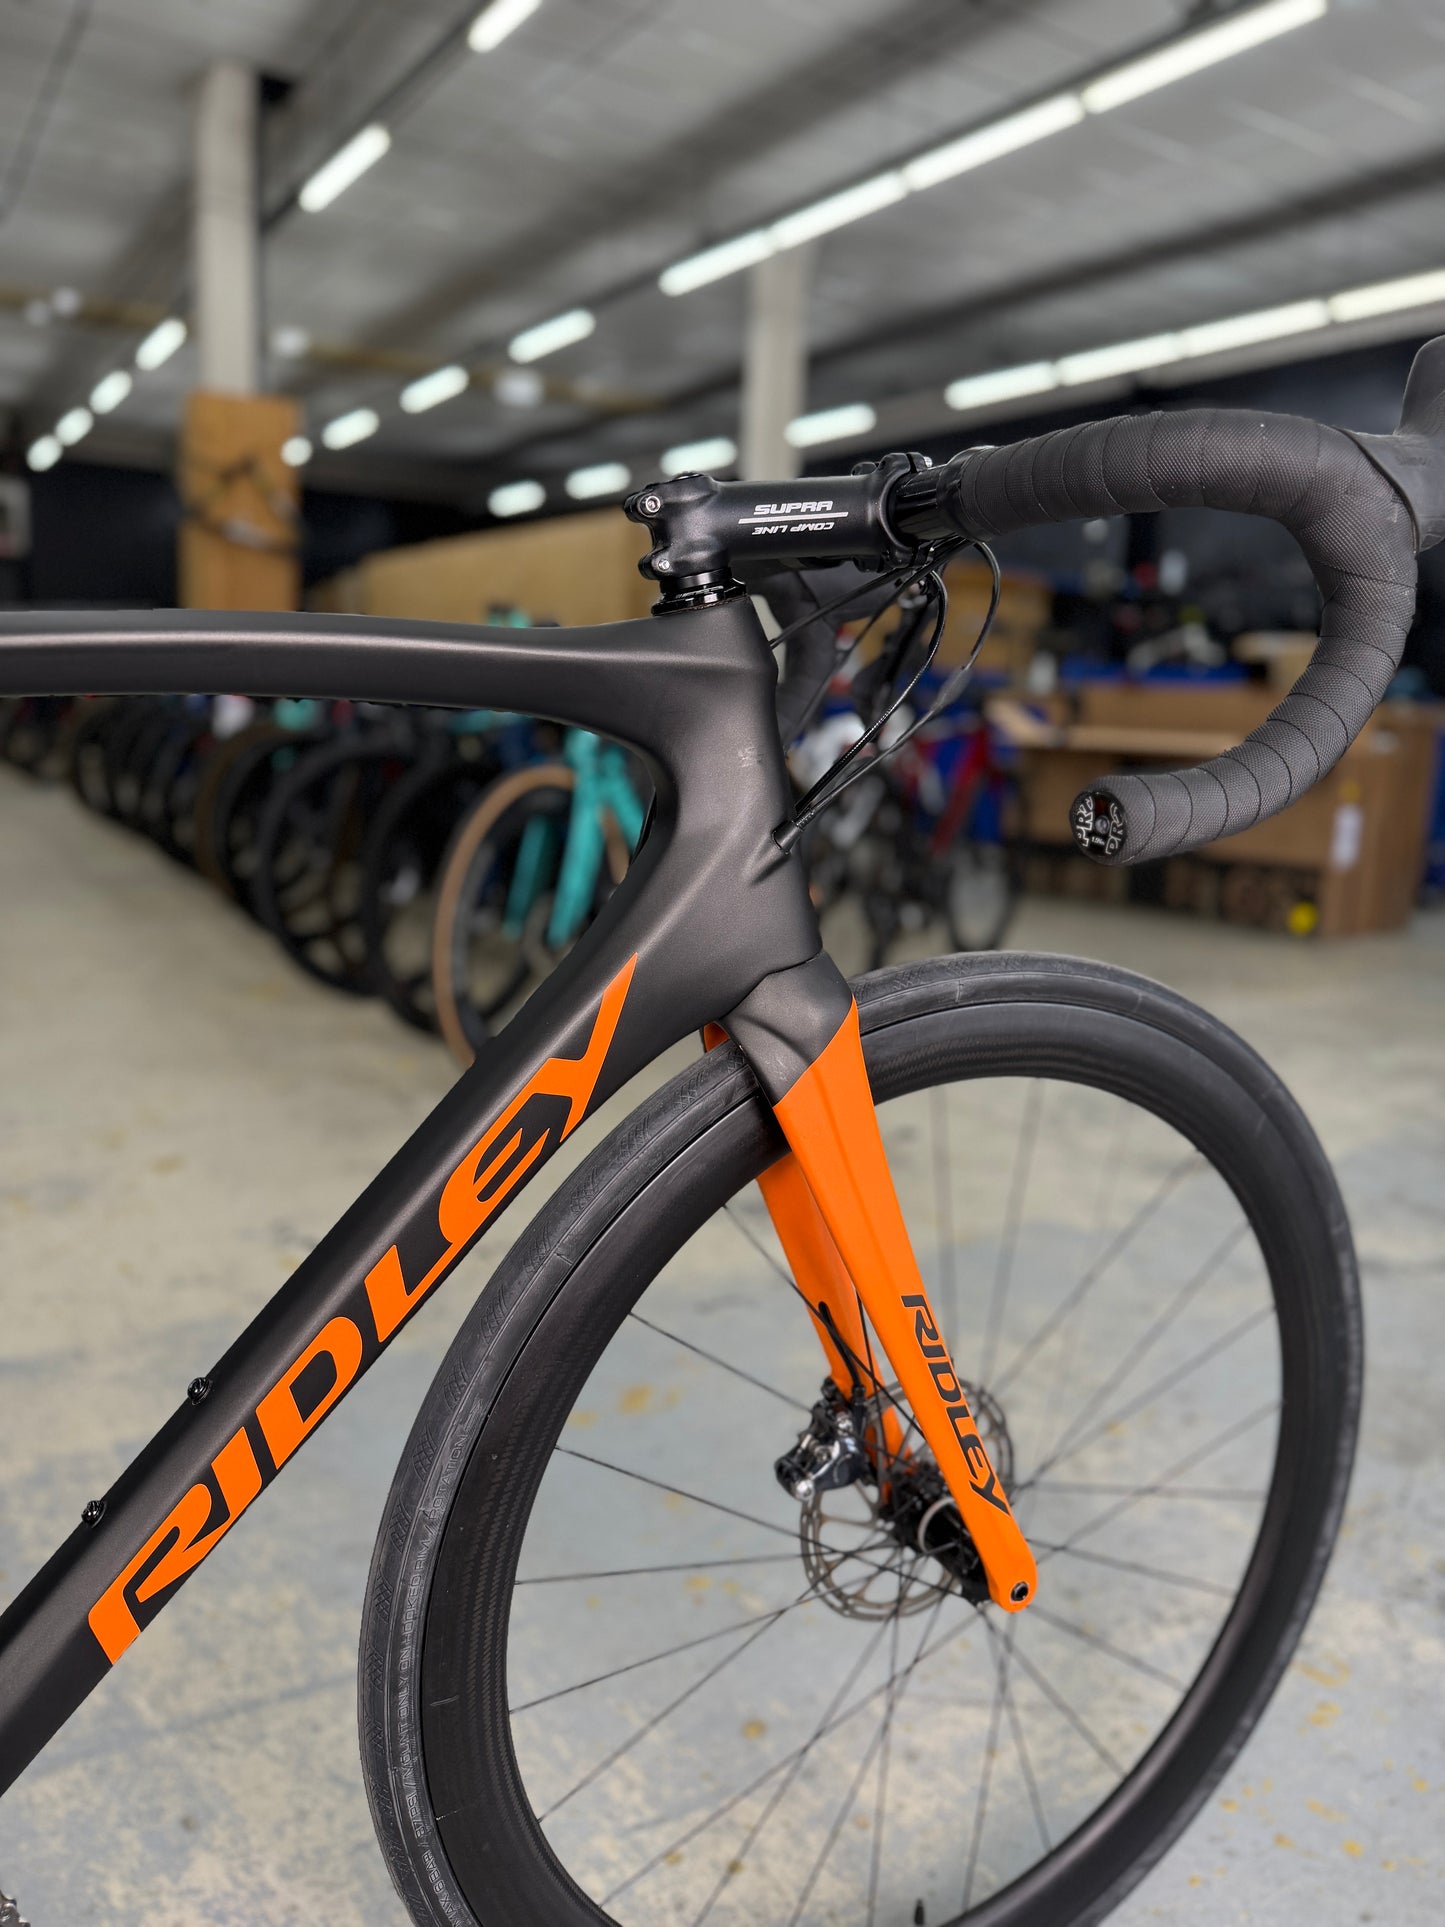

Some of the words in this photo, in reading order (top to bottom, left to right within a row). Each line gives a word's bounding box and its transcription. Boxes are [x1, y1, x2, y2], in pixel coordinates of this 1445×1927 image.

[753, 500, 834, 516] SUPRA
[751, 524, 788, 536] LINE
[789, 521, 836, 533] COMP
[88, 952, 637, 1664] RIDLEY
[900, 1294, 1011, 1517] RIDLEY
[428, 1434, 468, 1520] ROTATION
[415, 1538, 432, 1569] RIM
[402, 1575, 421, 1644] HOOKED
[400, 1650, 411, 1671] ON
[398, 1675, 410, 1719] ONLY
[398, 1724, 417, 1779] MOUNT
[406, 1791, 420, 1817] PSI
[412, 1820, 426, 1839] 87
[422, 1849, 441, 1883] BAR
[434, 1880, 446, 1893] 6
[439, 1893, 463, 1927] MAX
